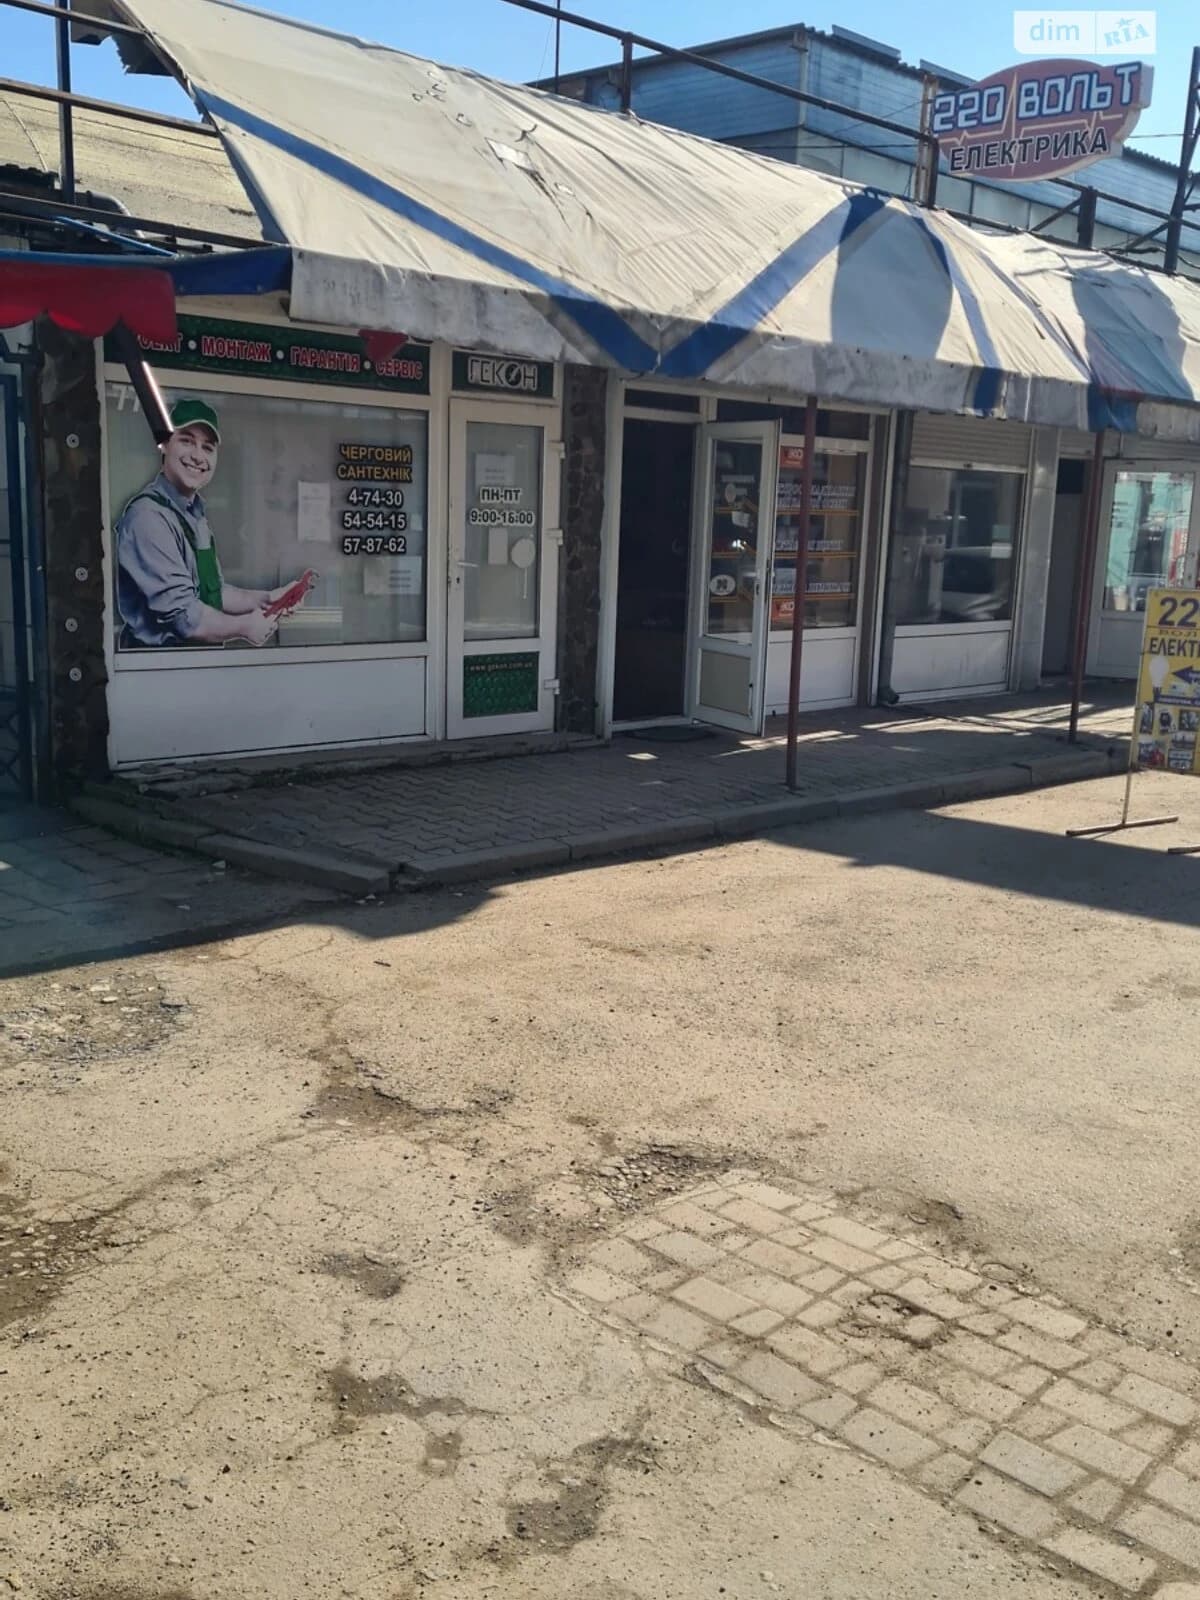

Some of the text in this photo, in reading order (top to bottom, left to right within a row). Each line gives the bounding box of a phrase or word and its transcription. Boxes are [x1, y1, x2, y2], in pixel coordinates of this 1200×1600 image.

[932, 61, 1142, 133] 220 ВОЛЬТ
[949, 127, 1109, 172] ЕЛЕКТРИКА
[202, 336, 271, 362] МОНТАЖ
[290, 346, 360, 373] ГАРАНТІЯ
[375, 359, 423, 381] СЕРВІС
[468, 356, 538, 391] ГЕКОН
[340, 445, 412, 463] ЧЕРГОВИЙ
[337, 464, 411, 481] САНТЕХНІК
[348, 488, 403, 507] 4-74-30
[480, 487, 521, 502] ПН-ПТ
[343, 512, 406, 529] 54-54-15
[470, 509, 534, 525] 9:00-16:00
[343, 537, 406, 553] 57-87-62
